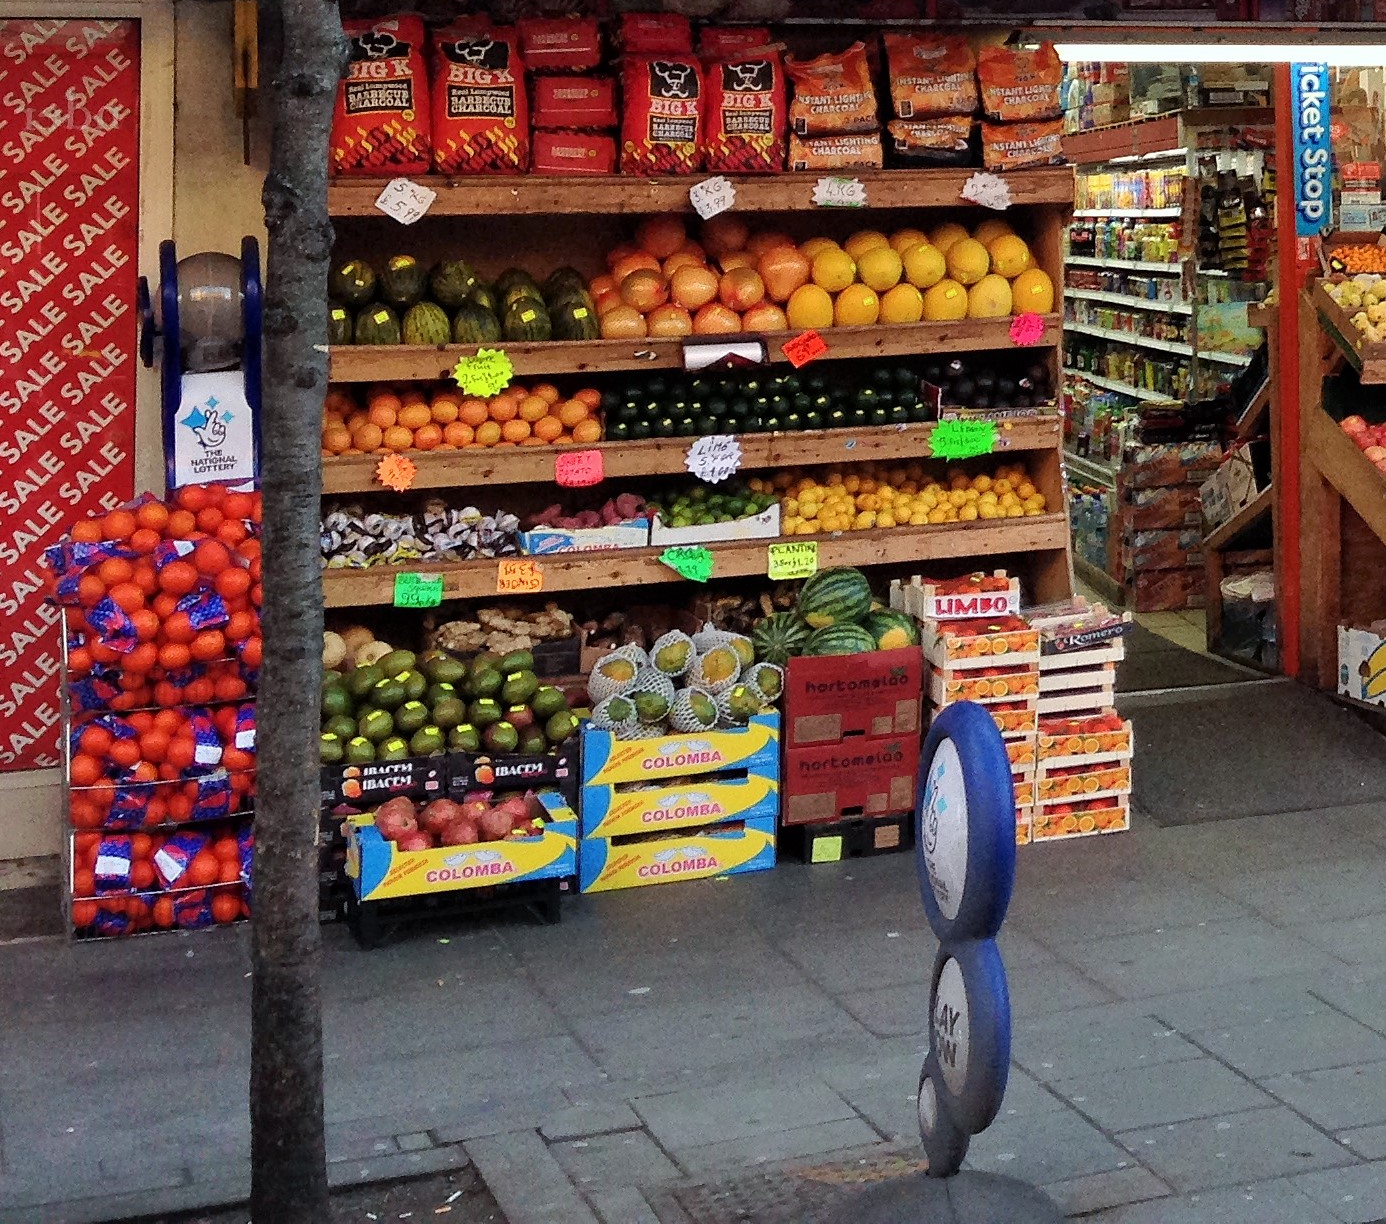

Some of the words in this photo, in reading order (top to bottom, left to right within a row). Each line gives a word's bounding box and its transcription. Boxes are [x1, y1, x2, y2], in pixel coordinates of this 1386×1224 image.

[3, 53, 70, 115] SALE
[65, 47, 132, 110] SALE
[348, 90, 409, 102] BARBECUE
[391, 59, 412, 76] K
[447, 64, 492, 84] BIG
[493, 68, 515, 83] K
[65, 97, 131, 158] SALE
[451, 96, 511, 106] BARBECUE
[451, 104, 511, 113] CHARCOAL
[649, 98, 682, 115] BIG
[684, 101, 699, 115] K
[721, 93, 756, 108] BIG
[758, 94, 773, 107] K
[810, 104, 860, 115] CHARCOAL
[1300, 62, 1325, 142] icket
[2, 103, 69, 164] SALE
[812, 145, 861, 156] CHARCOAL
[1, 153, 69, 214] SALE
[63, 146, 131, 207] SALE
[1300, 149, 1329, 221] Stop
[1, 201, 69, 264] SALE
[63, 195, 130, 256] SALE
[1, 251, 69, 314] SALE
[62, 244, 130, 306] SALE
[0, 301, 67, 364] SALE
[61, 293, 129, 356] SALE
[0, 351, 67, 414] SALE
[60, 343, 128, 405] SALE
[0, 401, 66, 464] SALE
[60, 392, 128, 456] SALE
[0, 451, 66, 515] SALE
[59, 441, 127, 505] SALE
[194, 464, 234, 473] LOTTERY
[0, 501, 64, 565] SALE
[0, 603, 62, 667] SALE
[934, 596, 1008, 616] LIMBO
[1069, 626, 1123, 646] Romero
[0, 652, 60, 717] SALE
[0, 703, 60, 764] SALE
[642, 751, 722, 770] COLOMBA
[642, 802, 722, 824] COLOMBA
[426, 861, 514, 883] COLOMBA
[637, 857, 718, 878] COLOMBA
